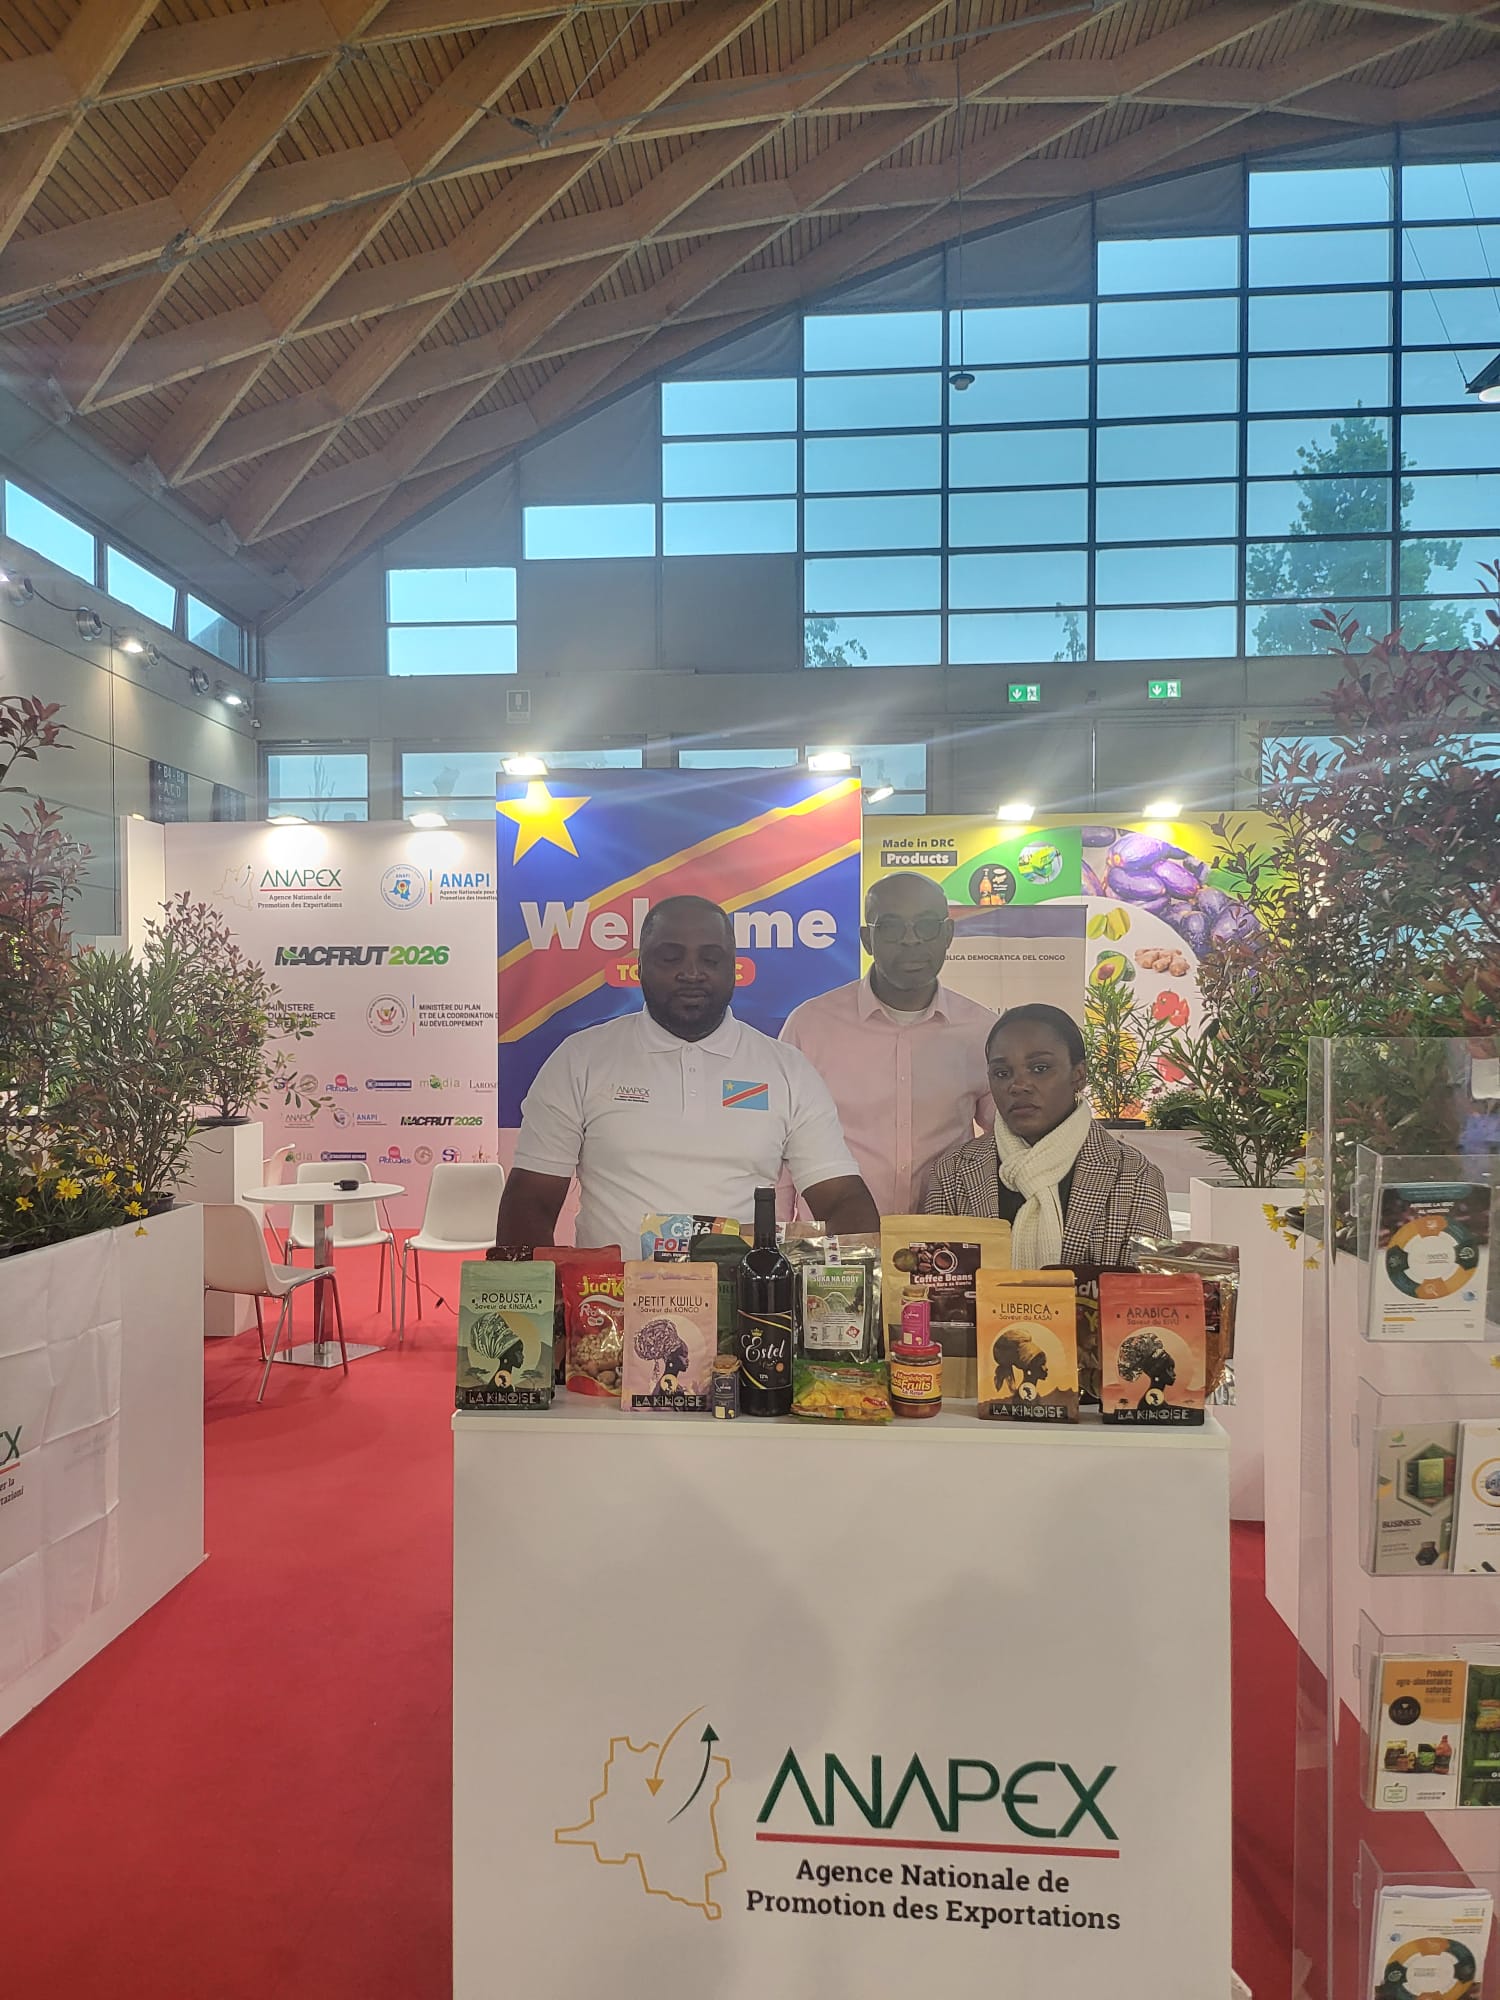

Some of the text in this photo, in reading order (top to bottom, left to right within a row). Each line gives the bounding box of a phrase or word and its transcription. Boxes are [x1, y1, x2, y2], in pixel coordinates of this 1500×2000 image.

[882, 838, 955, 848] Made in DRC
[886, 853, 949, 865] Products
[260, 869, 342, 887] ANAPEX
[440, 873, 490, 888] ANAPI
[269, 894, 291, 902] Agence
[519, 897, 837, 950] Welme
[274, 945, 450, 966] MACFRUT 2026
[419, 1003, 453, 1011] MINISTÈRE
[616, 1085, 650, 1097] ANAPEX
[400, 1117, 483, 1126] MACFRUT 2026
[670, 1221, 711, 1238] Café
[914, 1273, 973, 1284] Coffee Beans
[481, 1293, 533, 1304] ROBUSTA
[638, 1296, 703, 1307] PETIT KWILU
[1000, 1303, 1051, 1315] LIBERICA
[1126, 1307, 1179, 1319] ARABICA
[740, 1334, 785, 1363] Estel
[902, 1379, 931, 1391] Fruits
[468, 1391, 537, 1405] LA KINOISE
[634, 1395, 704, 1408] LA KINOISE
[992, 1404, 1065, 1418] LA KINOISE
[1117, 1409, 1190, 1421] LA KINOISE
[1382, 1519, 1422, 1529] BUSINESS
[756, 1745, 1120, 1841] ANAPEX
[796, 1859, 1071, 1893] Agence Nationale de
[746, 1890, 1121, 1930] Promotion des Exportations
